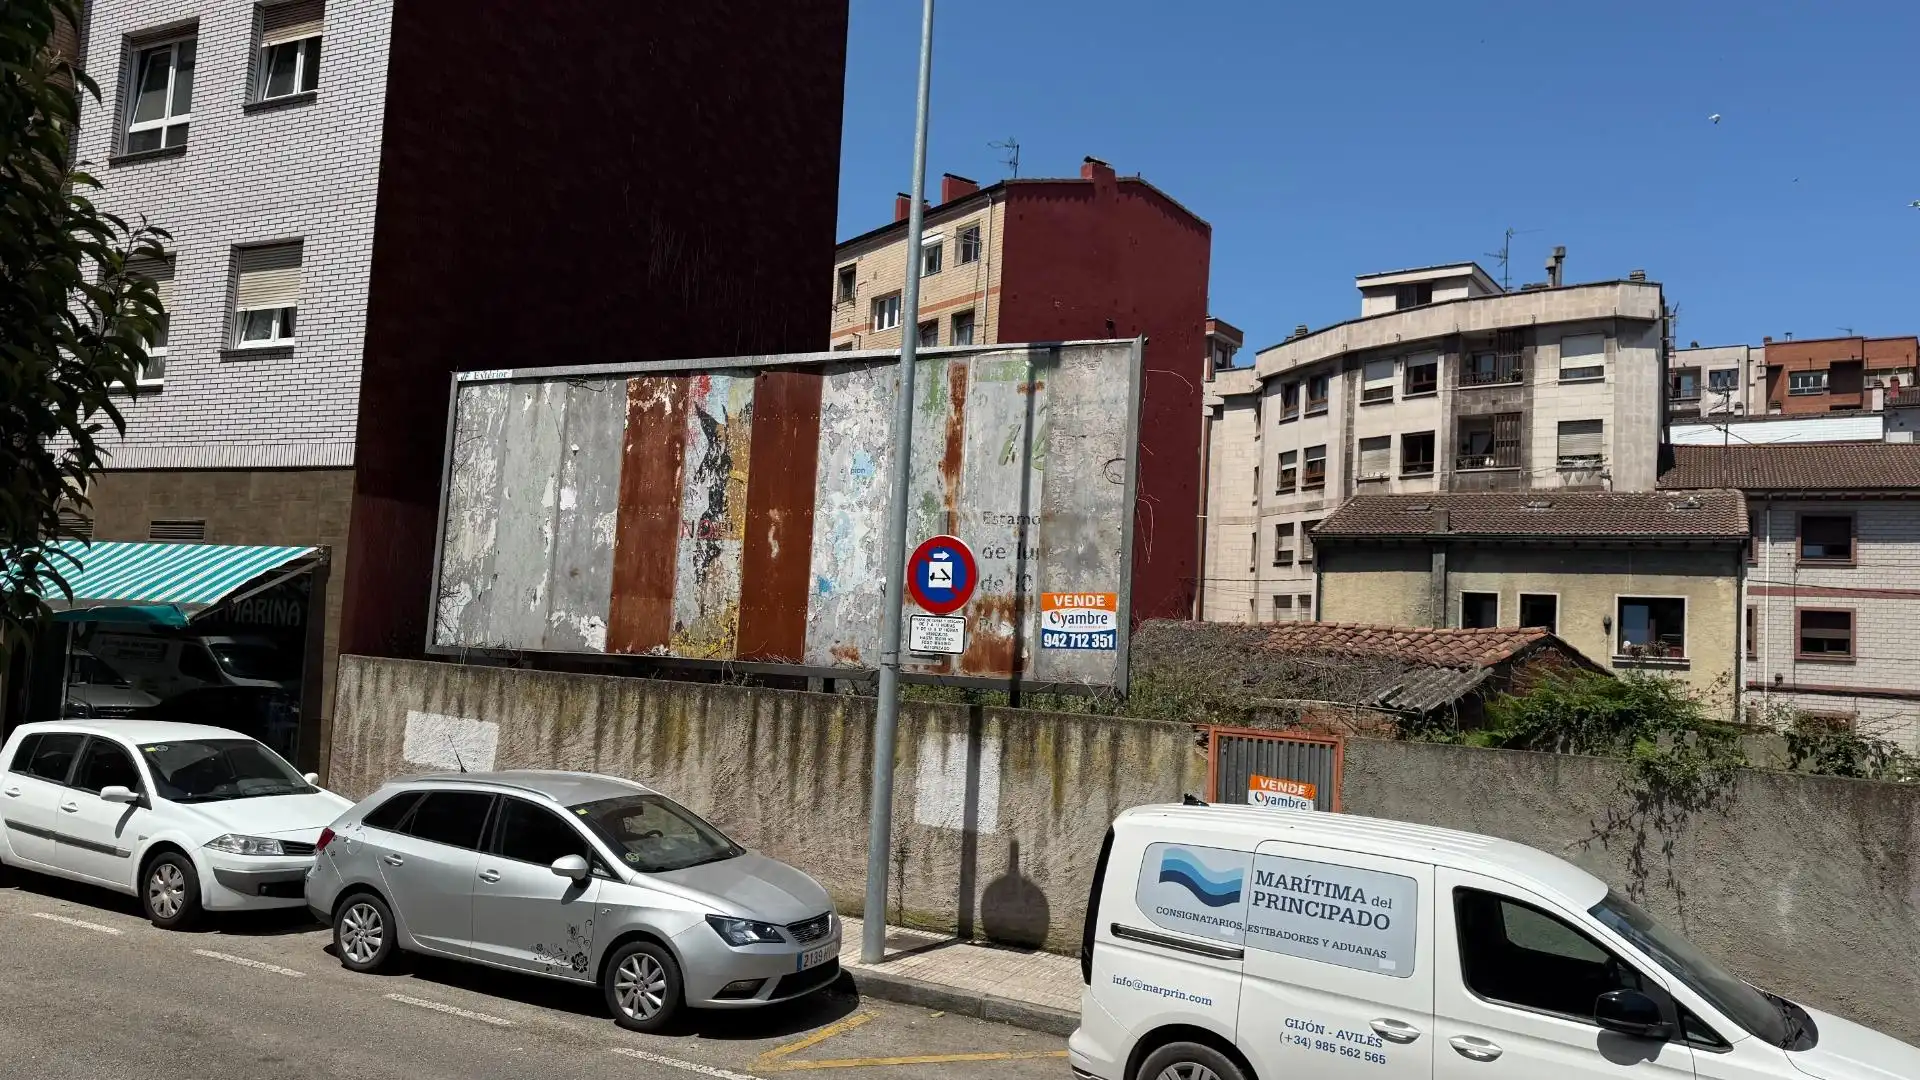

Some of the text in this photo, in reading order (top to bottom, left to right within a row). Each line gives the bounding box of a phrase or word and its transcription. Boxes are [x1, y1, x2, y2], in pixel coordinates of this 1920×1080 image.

[1053, 595, 1106, 607] VENDE
[1050, 610, 1108, 628] Oyambre
[1044, 633, 1113, 648] 942 712 351
[1254, 791, 1307, 810] Oyambre
[1260, 778, 1306, 795] VENDE
[1255, 869, 1392, 909] MARÍTIMA del
[1252, 890, 1391, 930] PRINCIPADO
[1156, 906, 1387, 959] CONSIGNATARIOS, ESTIBADORES Y ADUANAS
[1112, 974, 1212, 1006] info@marprin.com
[1279, 1031, 1386, 1065] (+34) 985 562 565
[1284, 1018, 1325, 1035] GIJÓN
[1336, 1029, 1383, 1048] AVILÉS
